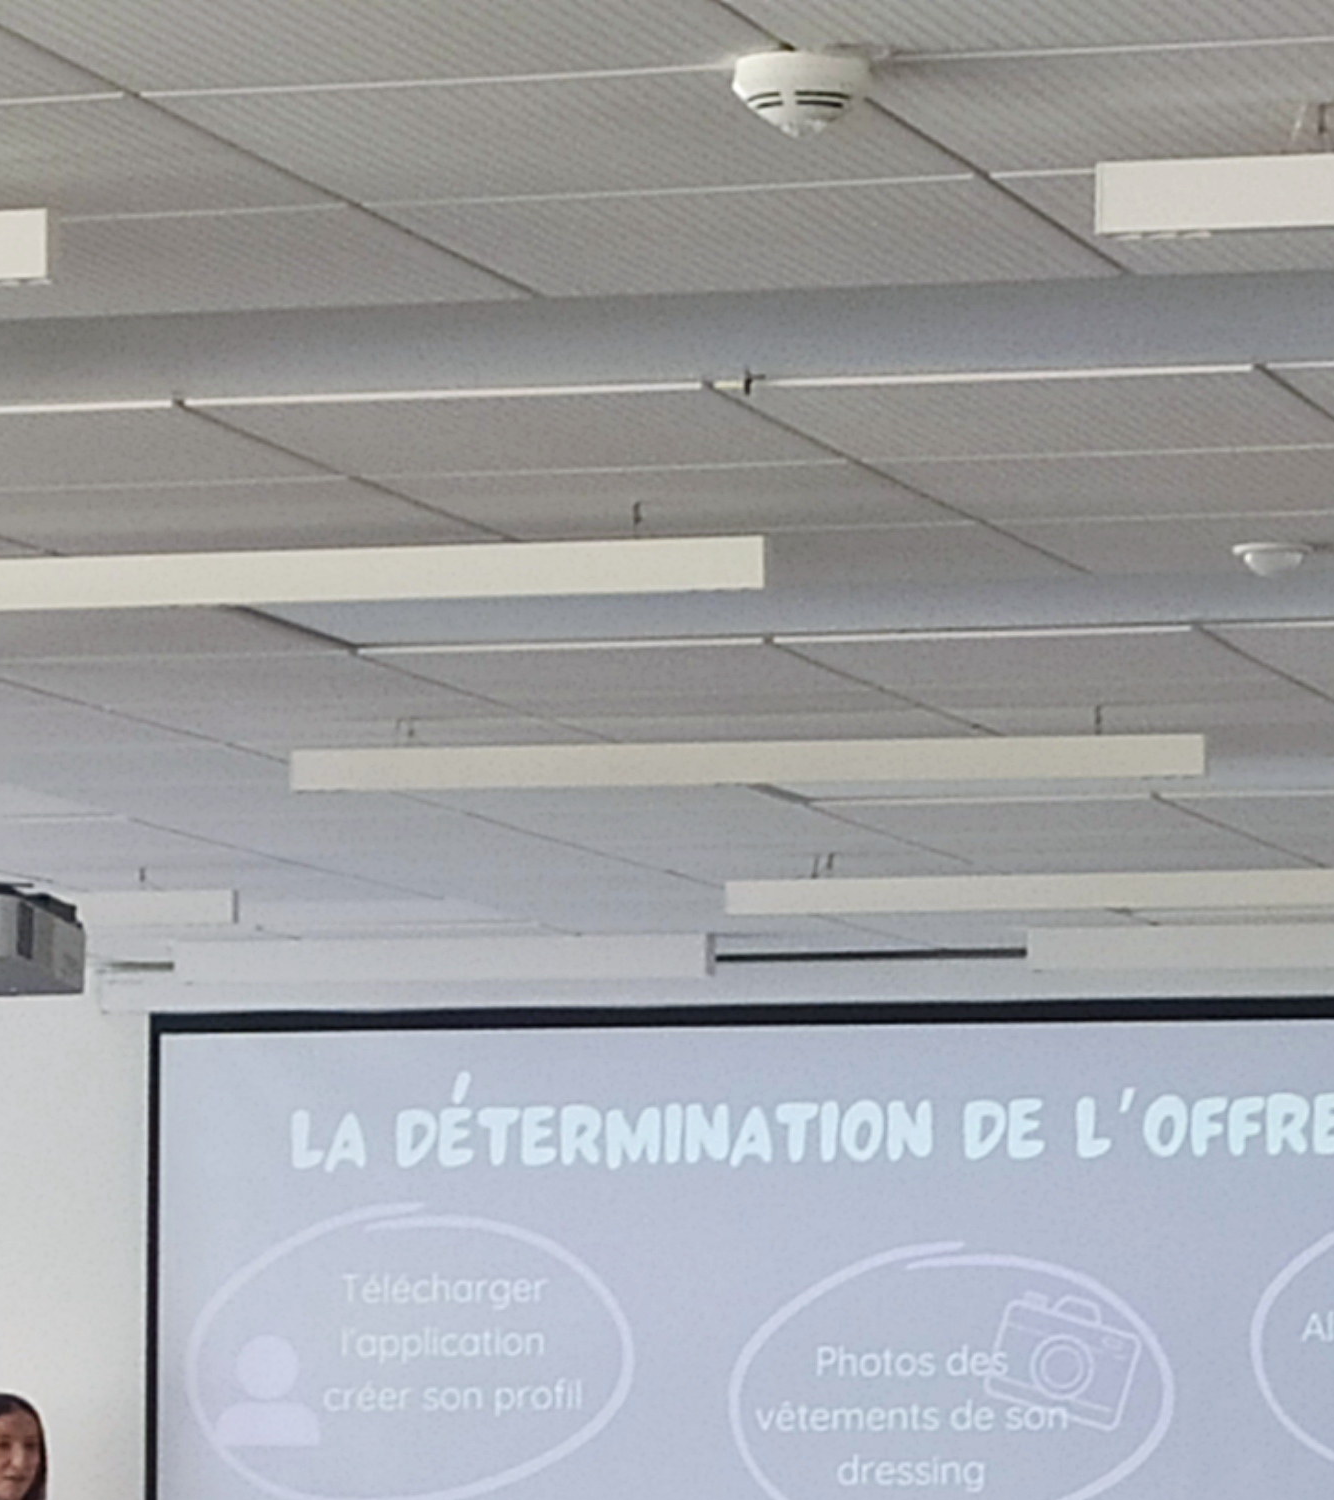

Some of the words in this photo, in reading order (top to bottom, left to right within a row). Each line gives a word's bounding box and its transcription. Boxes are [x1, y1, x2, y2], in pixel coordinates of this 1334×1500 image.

[291, 1109, 366, 1172] LA
[395, 1070, 932, 1169] DÉTERMINATION
[963, 1098, 1045, 1160] DE
[342, 1271, 548, 1311] Télécharger
[340, 1326, 546, 1366] l'application
[816, 1344, 936, 1378] Photos
[946, 1343, 1009, 1379] des
[322, 1376, 411, 1413] créer
[421, 1386, 483, 1413] son
[494, 1377, 583, 1418] profil
[755, 1399, 940, 1432] vêtements
[949, 1398, 993, 1432] de
[1002, 1404, 1069, 1432] son
[836, 1453, 986, 1494] dressing
